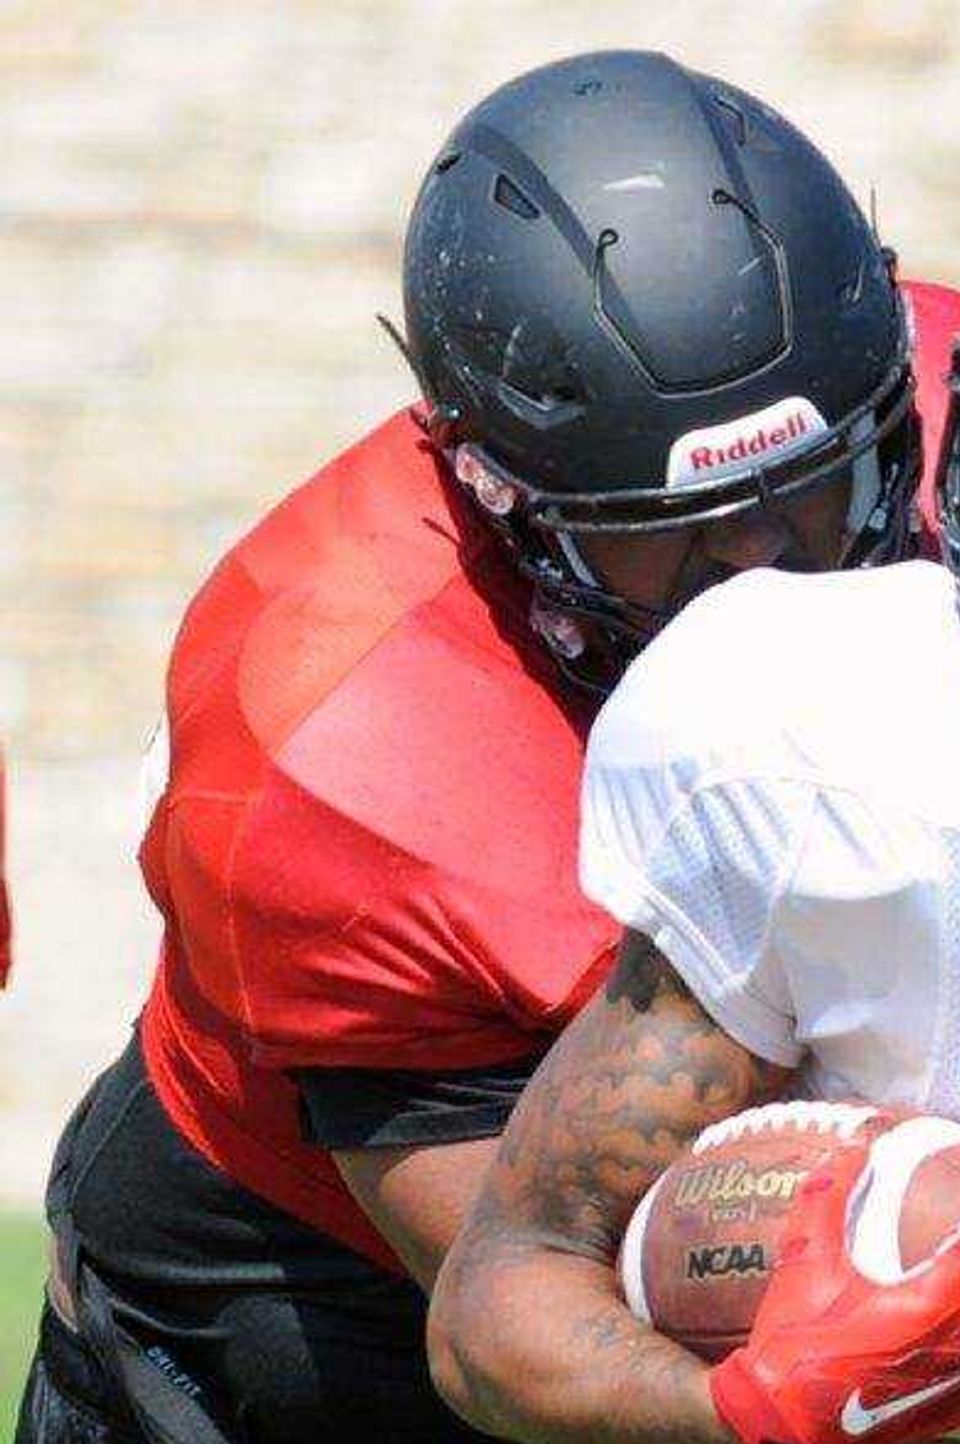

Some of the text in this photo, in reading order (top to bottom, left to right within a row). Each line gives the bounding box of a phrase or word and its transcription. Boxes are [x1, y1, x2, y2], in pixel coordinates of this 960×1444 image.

[691, 411, 807, 470] Riddell
[674, 1160, 809, 1206] Wilson
[687, 1243, 766, 1279] NCAA
